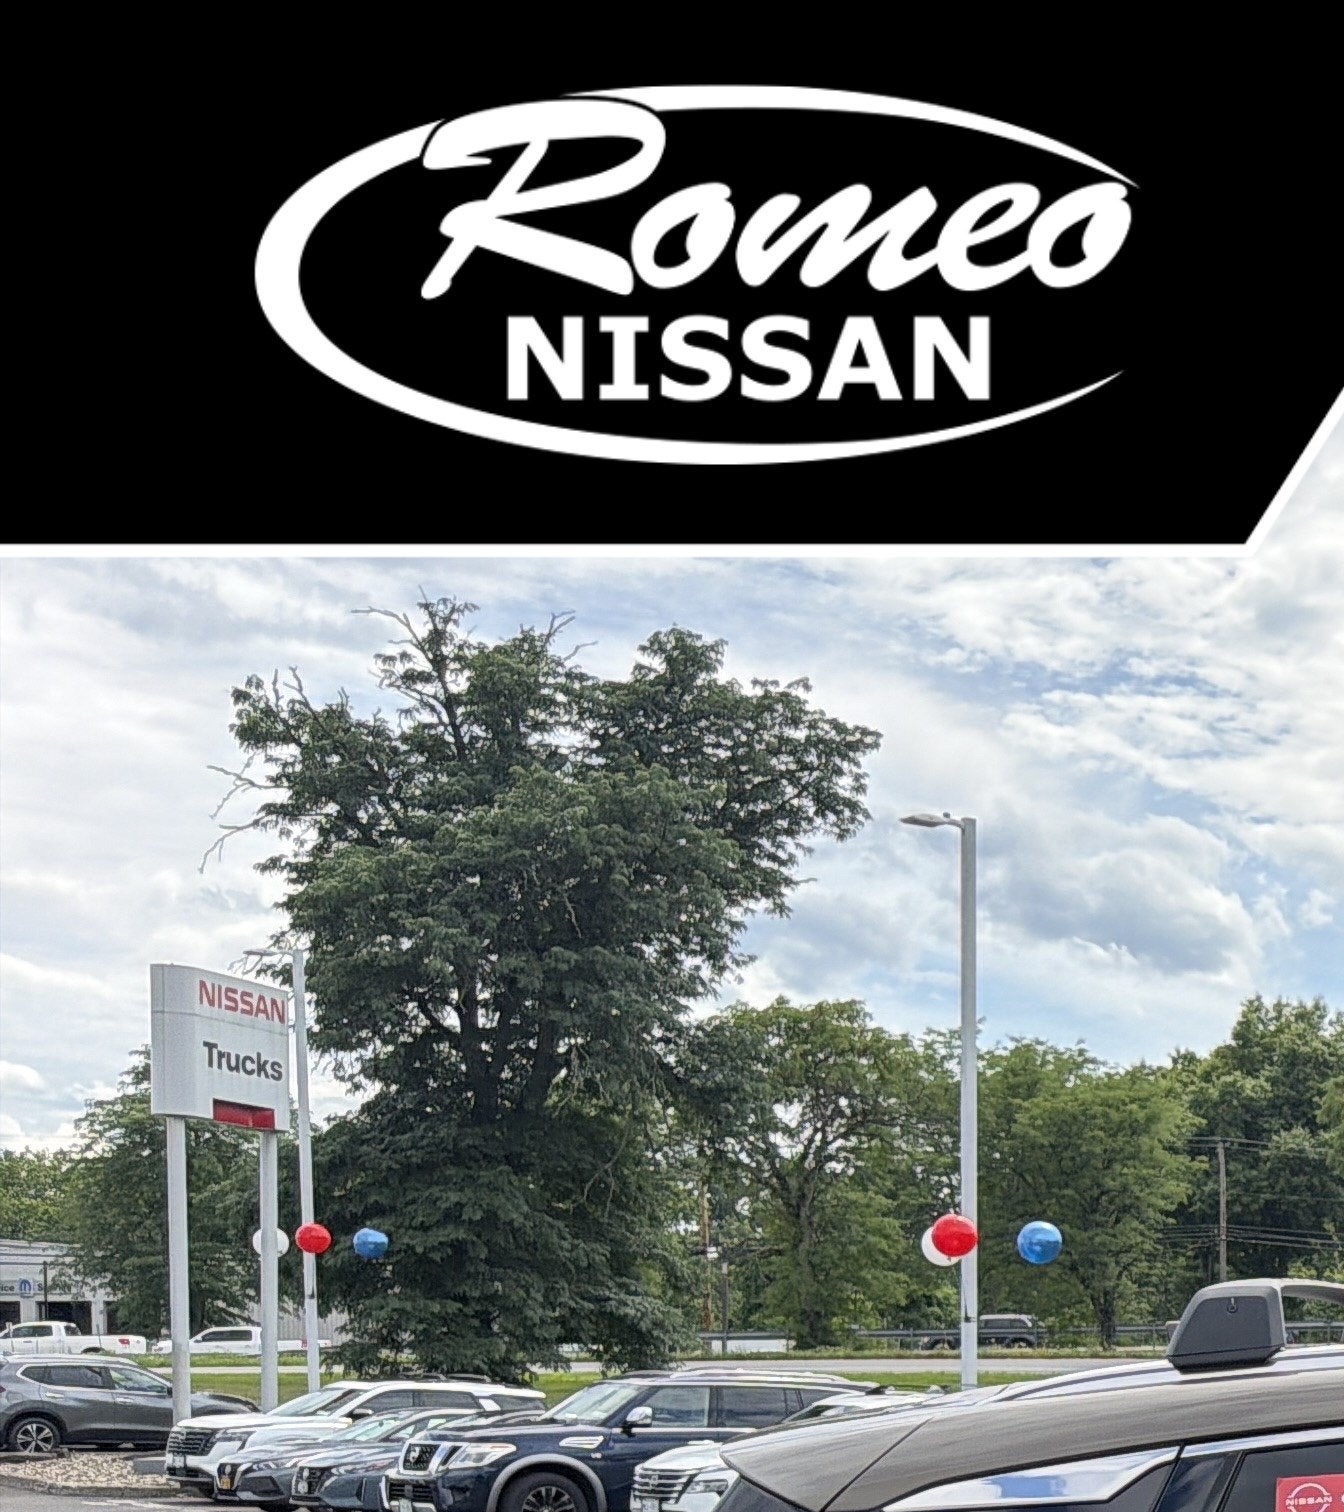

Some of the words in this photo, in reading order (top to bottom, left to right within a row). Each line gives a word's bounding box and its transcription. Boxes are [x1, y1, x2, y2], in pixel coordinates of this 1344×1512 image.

[198, 979, 286, 1024] NISSAN
[202, 1041, 283, 1082] Trucks
[1285, 1496, 1333, 1506] NISSAN
